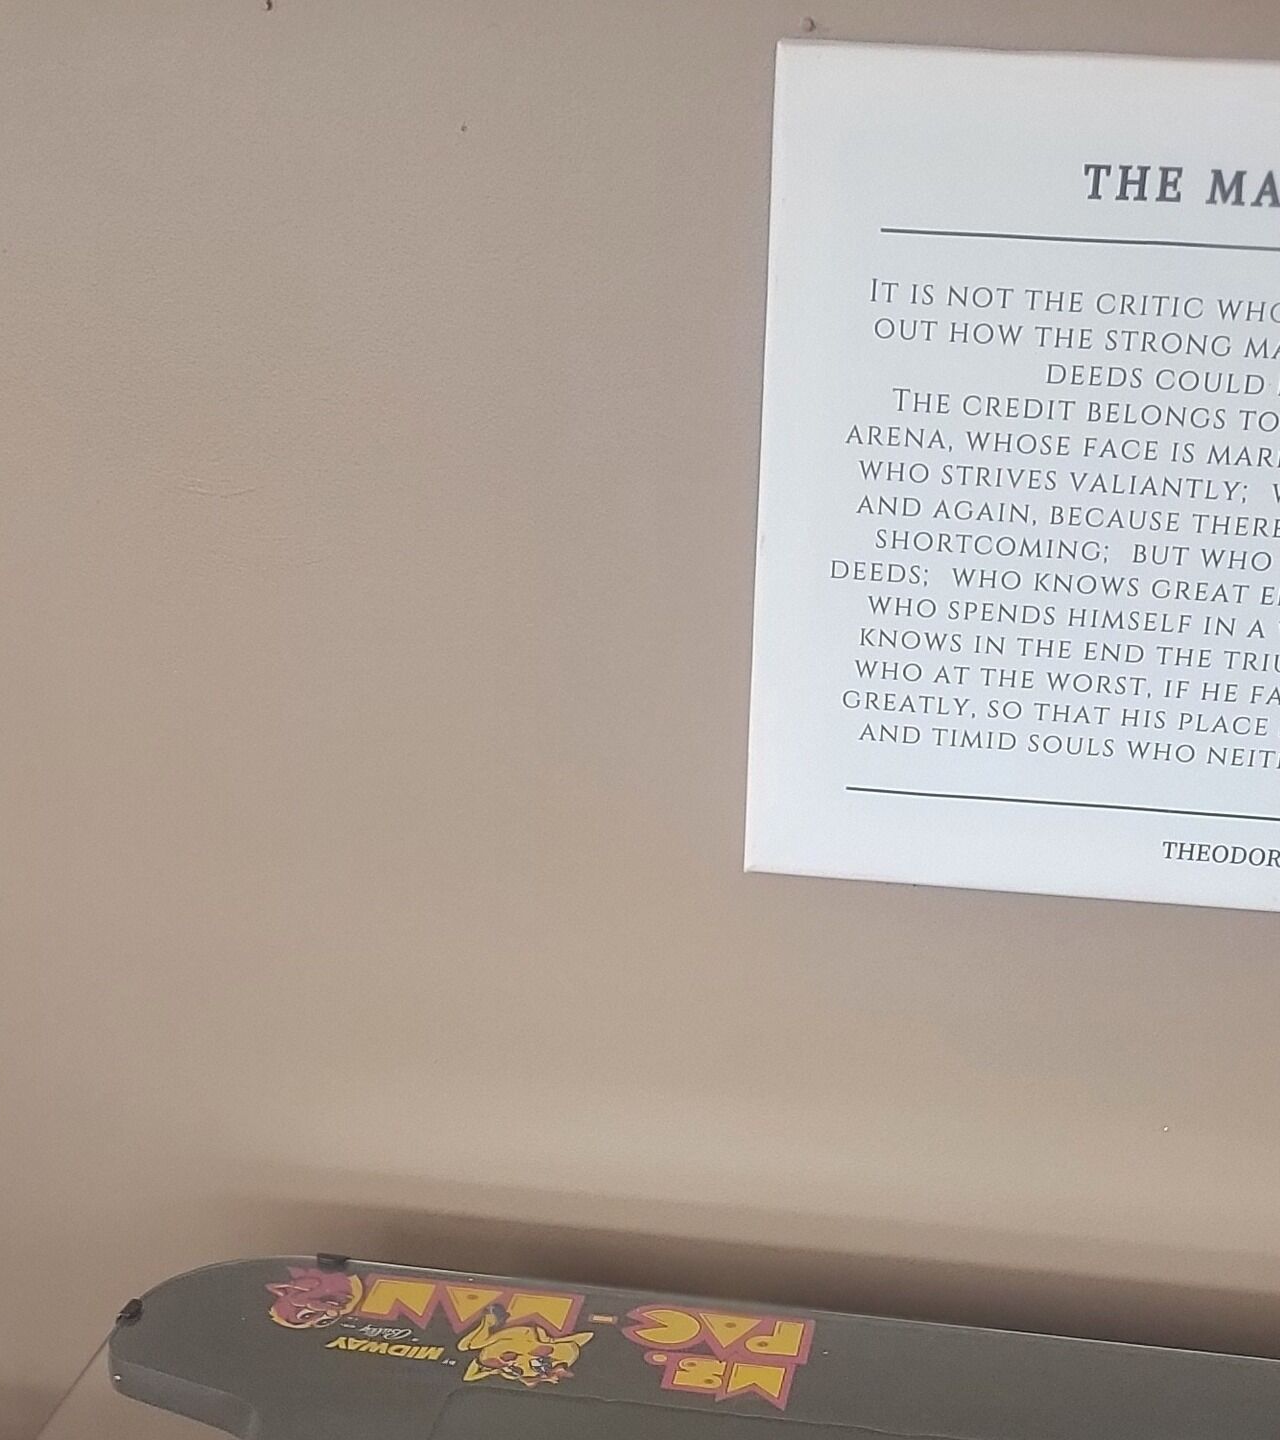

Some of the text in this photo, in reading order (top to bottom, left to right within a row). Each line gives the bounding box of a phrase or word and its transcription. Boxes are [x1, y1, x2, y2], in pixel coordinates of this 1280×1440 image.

[1082, 162, 1185, 204] THE
[870, 277, 900, 304] IT
[910, 282, 935, 307] IS
[946, 284, 1016, 310] NOT
[1023, 288, 1085, 314] THE
[1095, 292, 1205, 320] CRITIC
[873, 316, 939, 343] OUT
[948, 321, 1024, 347] HOW
[1034, 325, 1094, 351] THE
[1104, 328, 1232, 358] STRONG
[1045, 363, 1144, 390] DEEDS
[1154, 368, 1266, 396] COULD
[891, 387, 951, 415] THE
[961, 394, 1077, 422] CREDIT
[1086, 400, 1227, 431] BELONGS
[1238, 408, 1280, 434] TO
[844, 423, 954, 453] ARENA,
[965, 430, 1071, 457] WHOSE
[1082, 436, 1159, 462] FACE
[1170, 441, 1196, 465] IS
[858, 459, 930, 485] WHO
[940, 463, 1058, 492] STRIVES
[1069, 470, 1249, 505] VALIANTLY;
[855, 494, 923, 518] AND
[931, 498, 1038, 527] AGAIN,
[1049, 504, 1181, 533] BECAUSE
[874, 527, 1110, 565] SHORTCOMING;
[1131, 543, 1191, 567] BUT
[1200, 547, 1273, 573] WHO
[829, 558, 930, 588] DEEDS;
[951, 566, 1023, 591] WHO
[1033, 571, 1140, 598] KNOWS
[1150, 578, 1251, 605] GREAT
[867, 594, 938, 619] WHO
[947, 599, 1056, 627] SPENDS
[1067, 607, 1193, 635] HIMSELF
[1202, 615, 1237, 638] IN
[1245, 618, 1266, 640] A
[859, 627, 963, 654] KNOWS
[973, 634, 1006, 656] IN
[1015, 636, 1073, 660] THE
[1083, 640, 1145, 665] END
[1155, 645, 1213, 669] THE
[854, 658, 924, 683] WHO
[932, 664, 971, 686] AT
[979, 666, 1035, 690] THE
[1046, 671, 1152, 700] WORST,
[1163, 678, 1191, 700] IF
[1200, 681, 1239, 704] HE
[841, 689, 977, 720] GREATLY,
[986, 698, 1024, 721] SO
[1032, 701, 1112, 726] THAT
[1120, 707, 1167, 731] HIS
[1177, 711, 1269, 738] PLACE
[857, 722, 922, 746] AND
[930, 726, 1018, 752] TIMID
[1026, 733, 1115, 759] SOULS
[1126, 739, 1197, 764] WHO
[325, 1336, 444, 1361] MIDWAY
[646, 1353, 795, 1408] MS.
